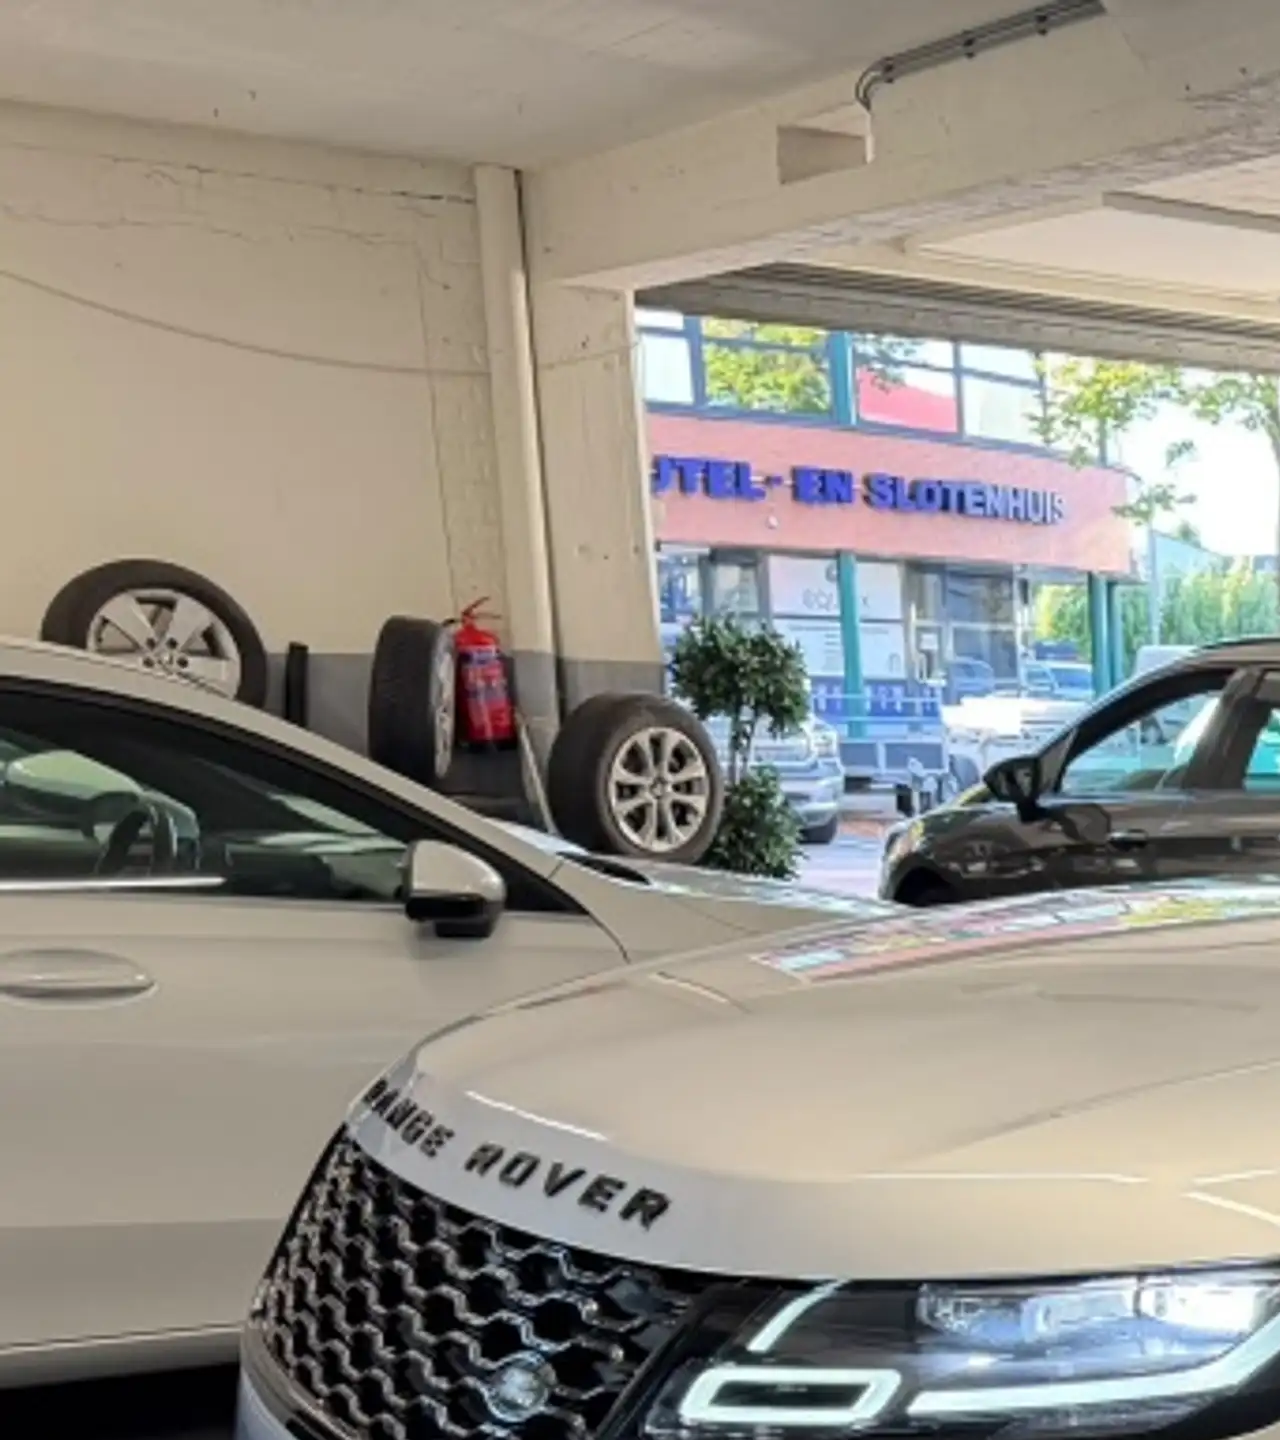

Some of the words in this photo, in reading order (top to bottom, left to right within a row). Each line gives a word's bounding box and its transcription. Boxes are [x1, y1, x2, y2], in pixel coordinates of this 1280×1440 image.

[790, 465, 855, 506] EN
[863, 471, 1067, 525] SLOTENHUIS
[361, 1077, 456, 1158] RANGE
[464, 1142, 674, 1232] ROVER
